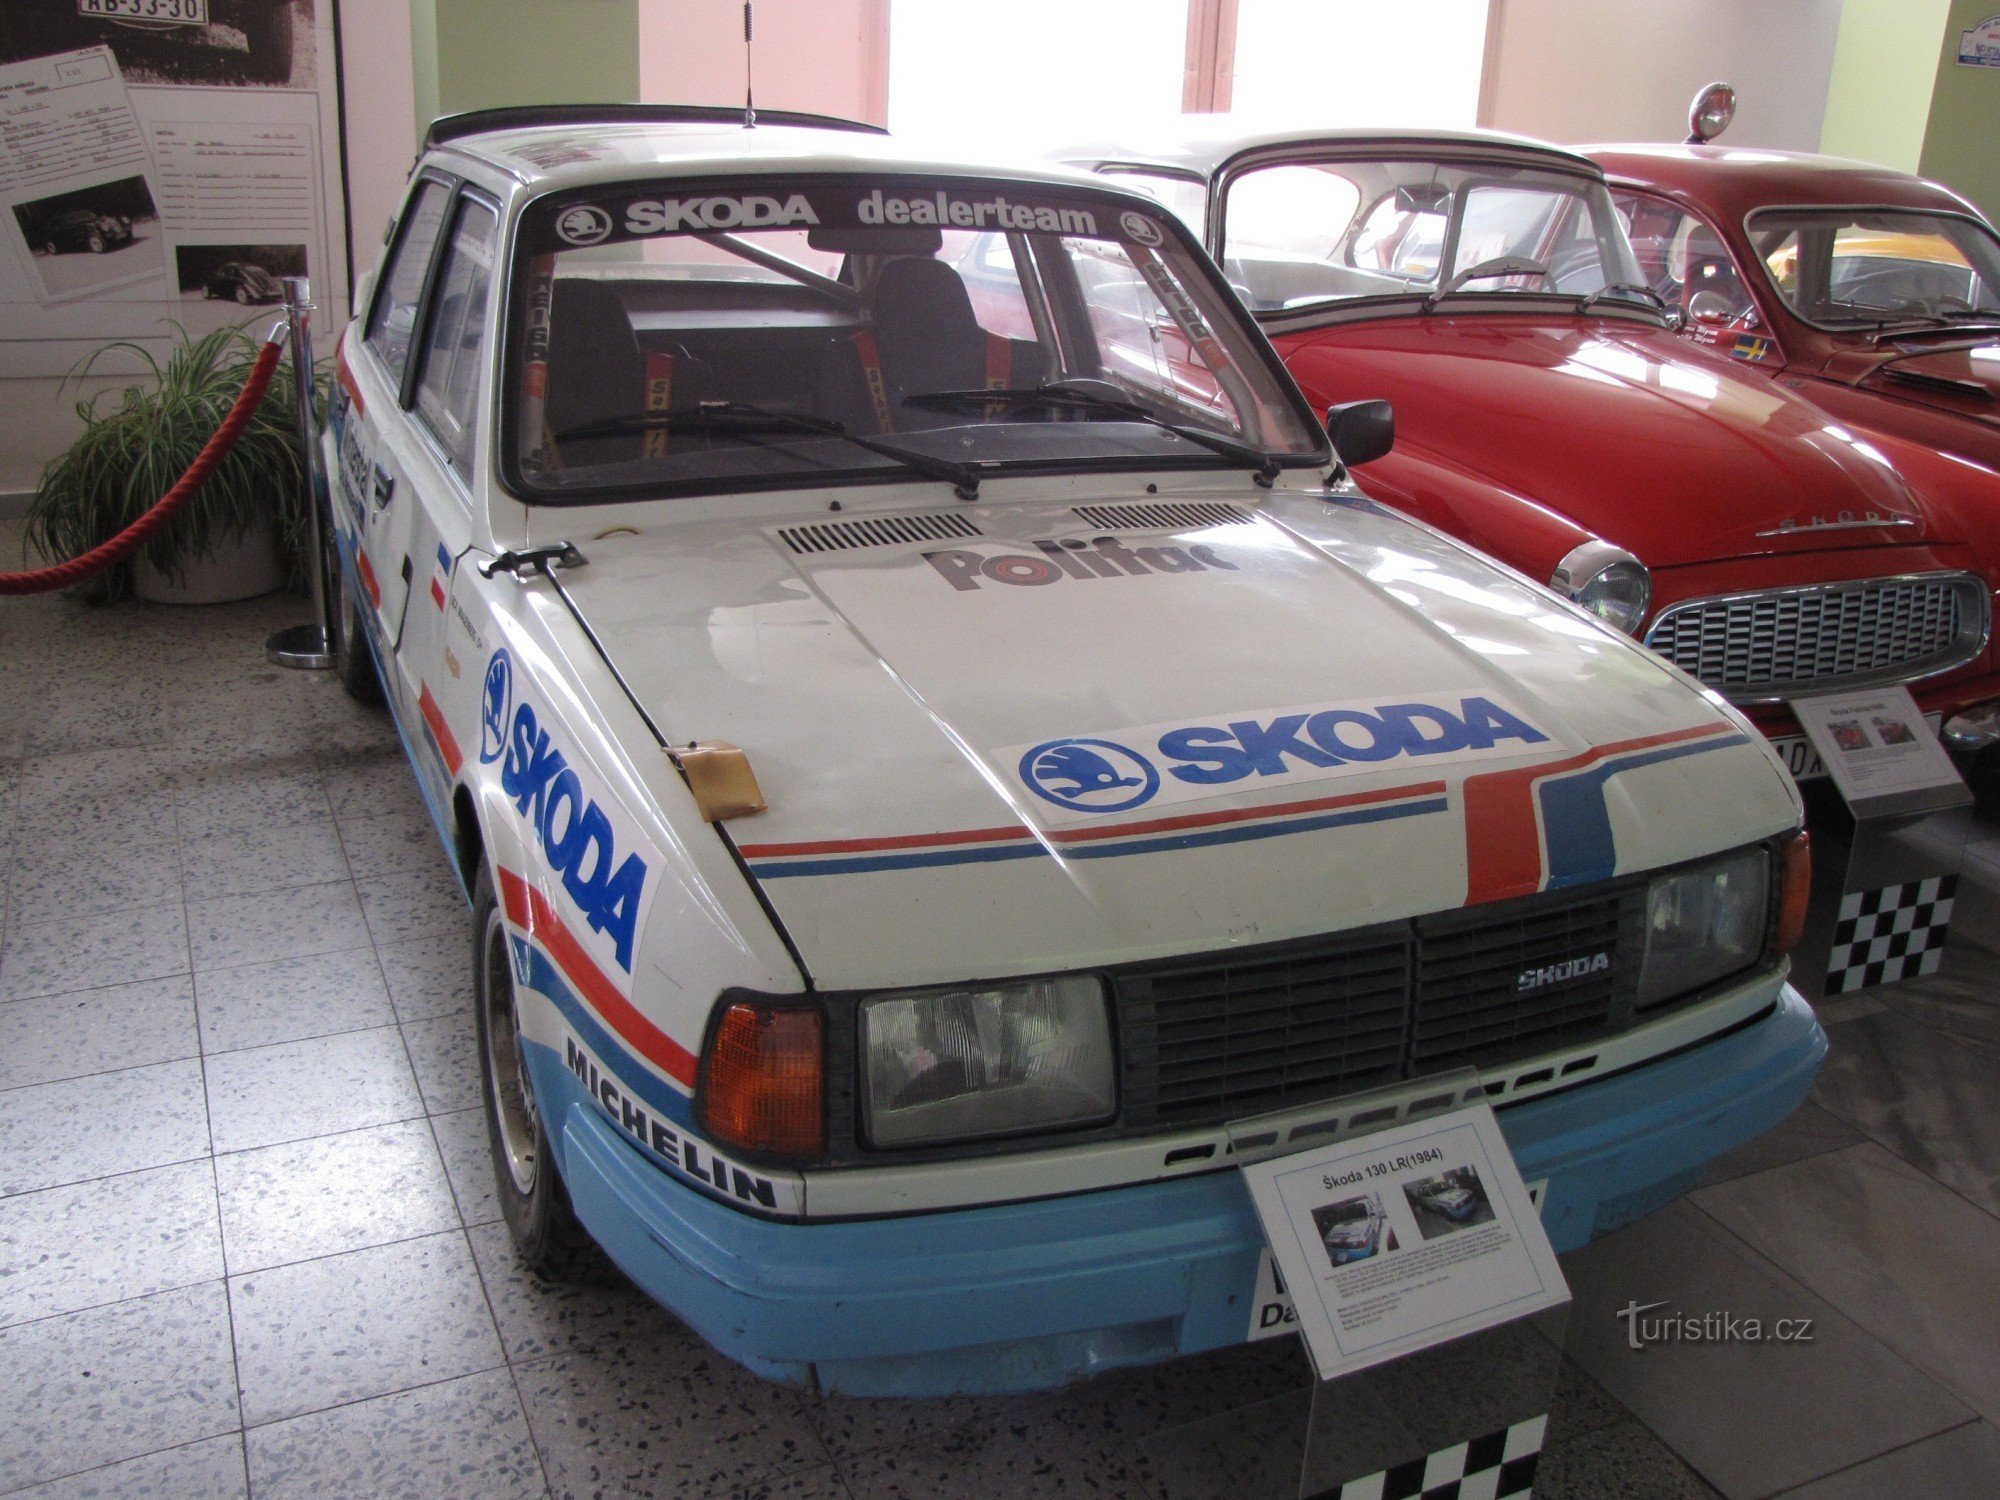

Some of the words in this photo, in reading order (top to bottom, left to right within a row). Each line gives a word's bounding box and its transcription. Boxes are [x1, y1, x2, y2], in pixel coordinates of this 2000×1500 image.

[625, 195, 820, 234] SKODA
[858, 190, 1097, 234] dealerteam
[920, 536, 1239, 591] Polifac
[1158, 697, 1550, 785] SKODA
[502, 703, 647, 975] SKODA
[1518, 952, 1608, 990] SKODA
[567, 1035, 777, 1208] MICHELIN
[1322, 1171, 1363, 1190] Škoda
[1365, 1163, 1387, 1178] 130
[1389, 1147, 1443, 1172] LR(1984)
